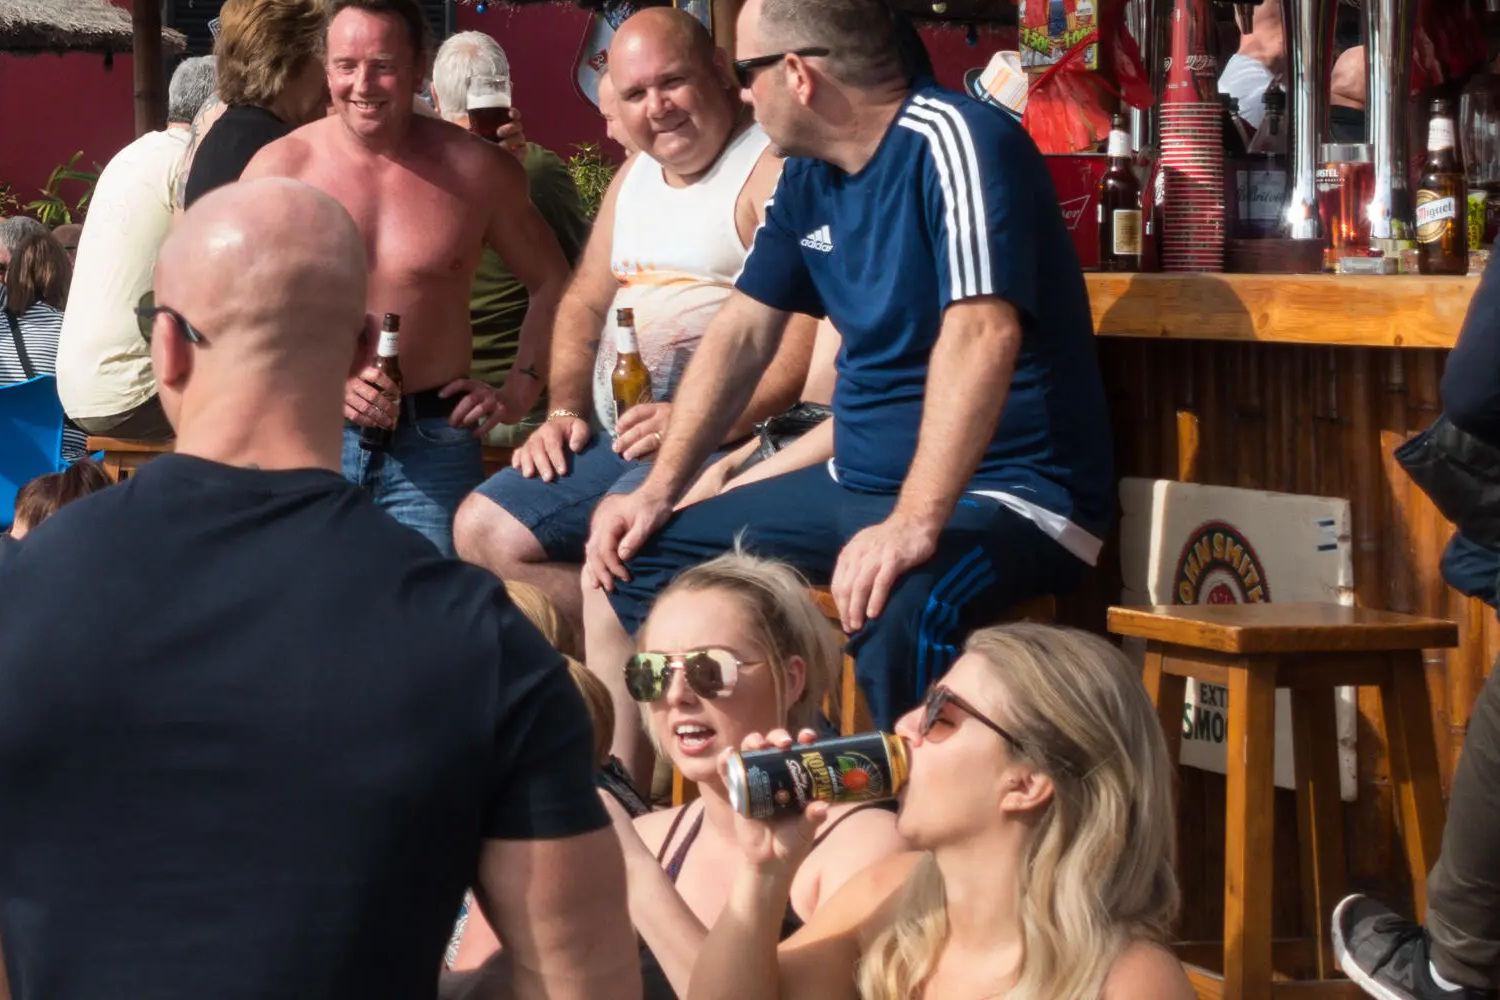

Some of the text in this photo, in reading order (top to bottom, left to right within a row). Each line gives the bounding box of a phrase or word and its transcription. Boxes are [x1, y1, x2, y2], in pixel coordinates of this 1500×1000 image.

[801, 238, 833, 252] adidas
[1179, 536, 1212, 605] OHN
[1199, 682, 1229, 708] EXT
[1182, 702, 1229, 744] SMO
